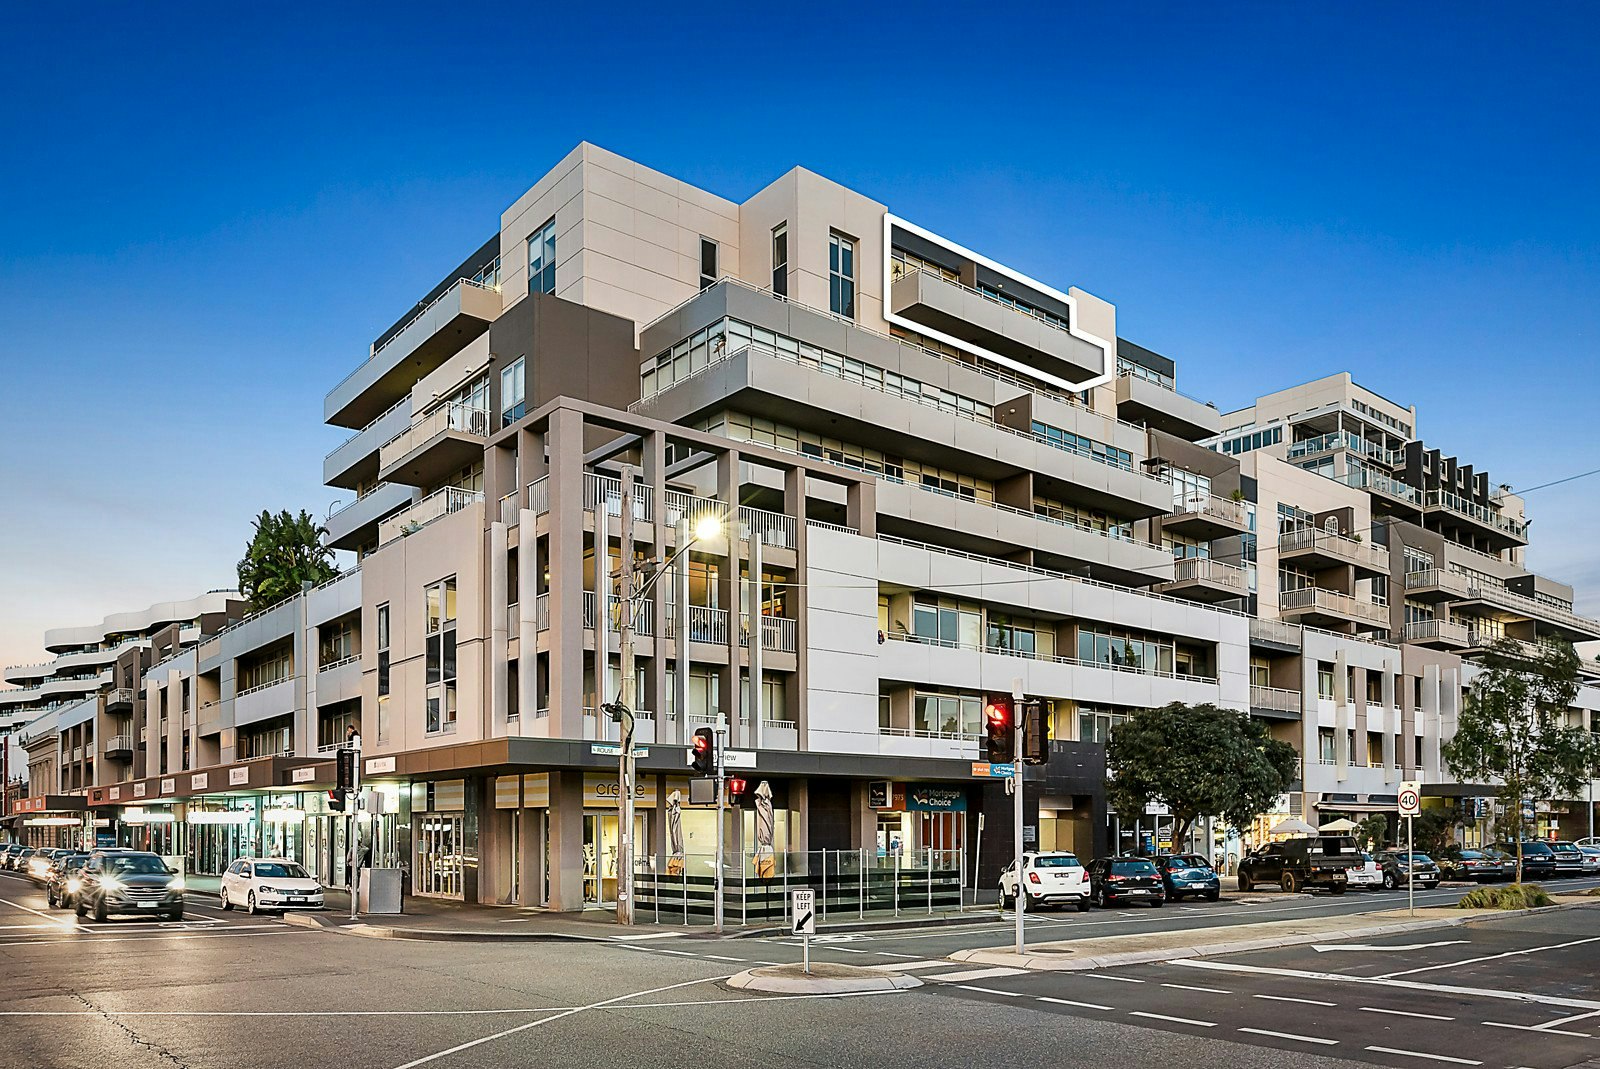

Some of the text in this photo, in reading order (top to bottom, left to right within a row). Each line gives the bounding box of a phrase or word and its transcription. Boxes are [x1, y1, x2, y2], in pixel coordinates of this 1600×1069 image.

[929, 789, 960, 799] Mortgage
[929, 798, 952, 806] Choice
[1402, 795, 1416, 805] 40
[796, 893, 811, 901] KEEP
[796, 902, 811, 910] LEFT
